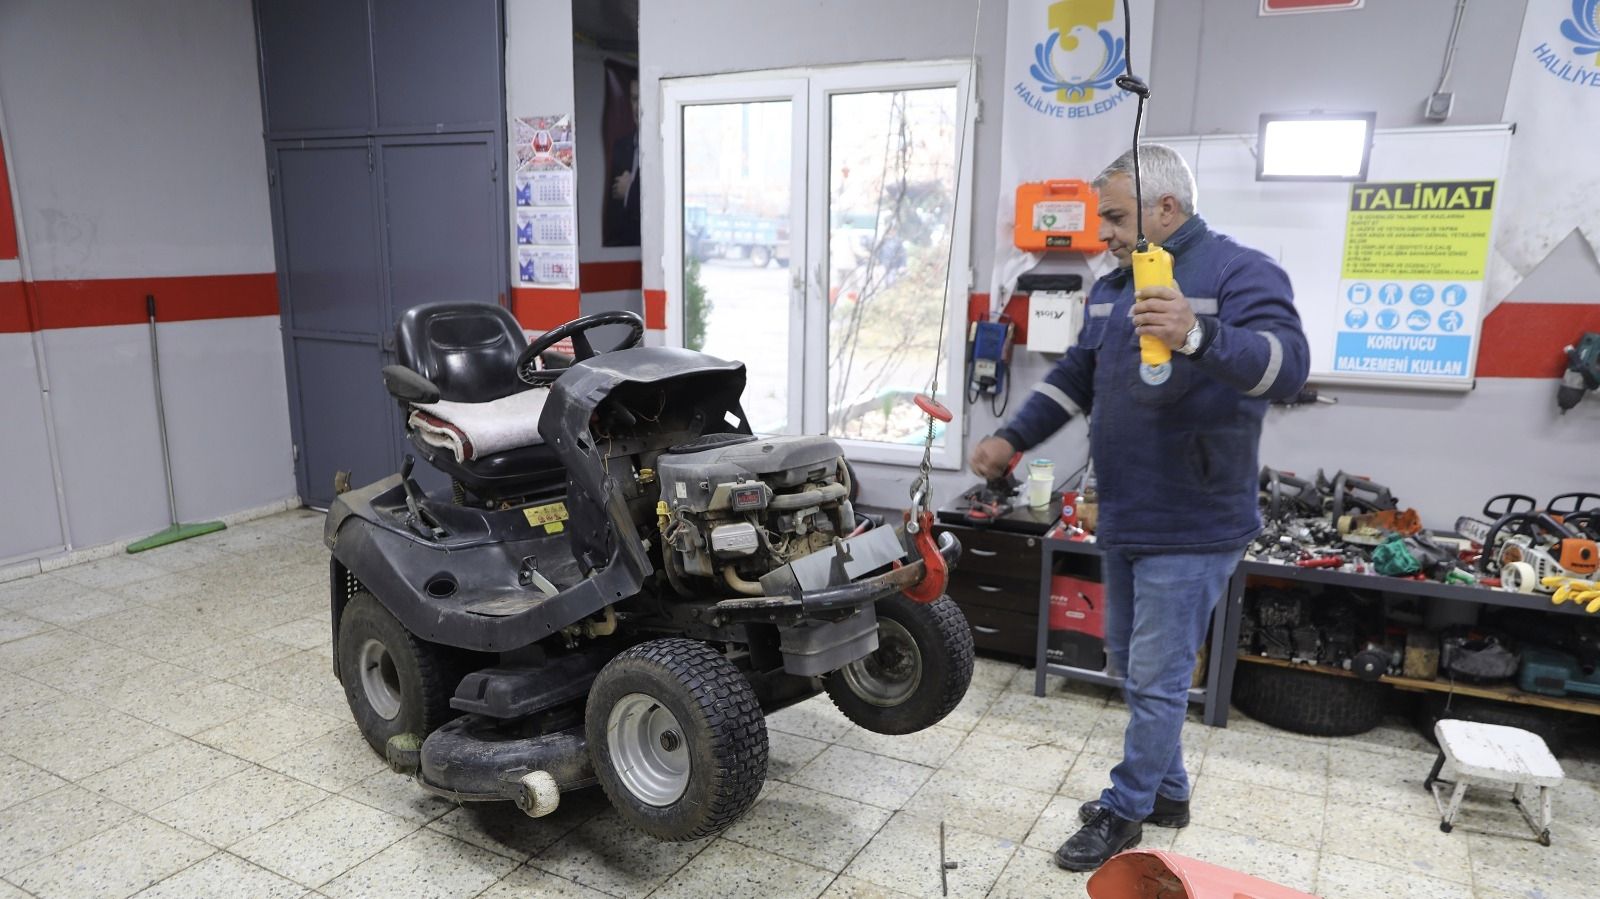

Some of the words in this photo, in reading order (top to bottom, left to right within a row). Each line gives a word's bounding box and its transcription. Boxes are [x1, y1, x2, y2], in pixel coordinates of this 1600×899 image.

[1014, 82, 1064, 118] HALİLİYE
[1355, 183, 1491, 210] TALİMAT
[1366, 335, 1437, 351] KORUYUCU
[1337, 355, 1408, 373] MALZEMENİ
[1410, 359, 1462, 375] KULLAN
